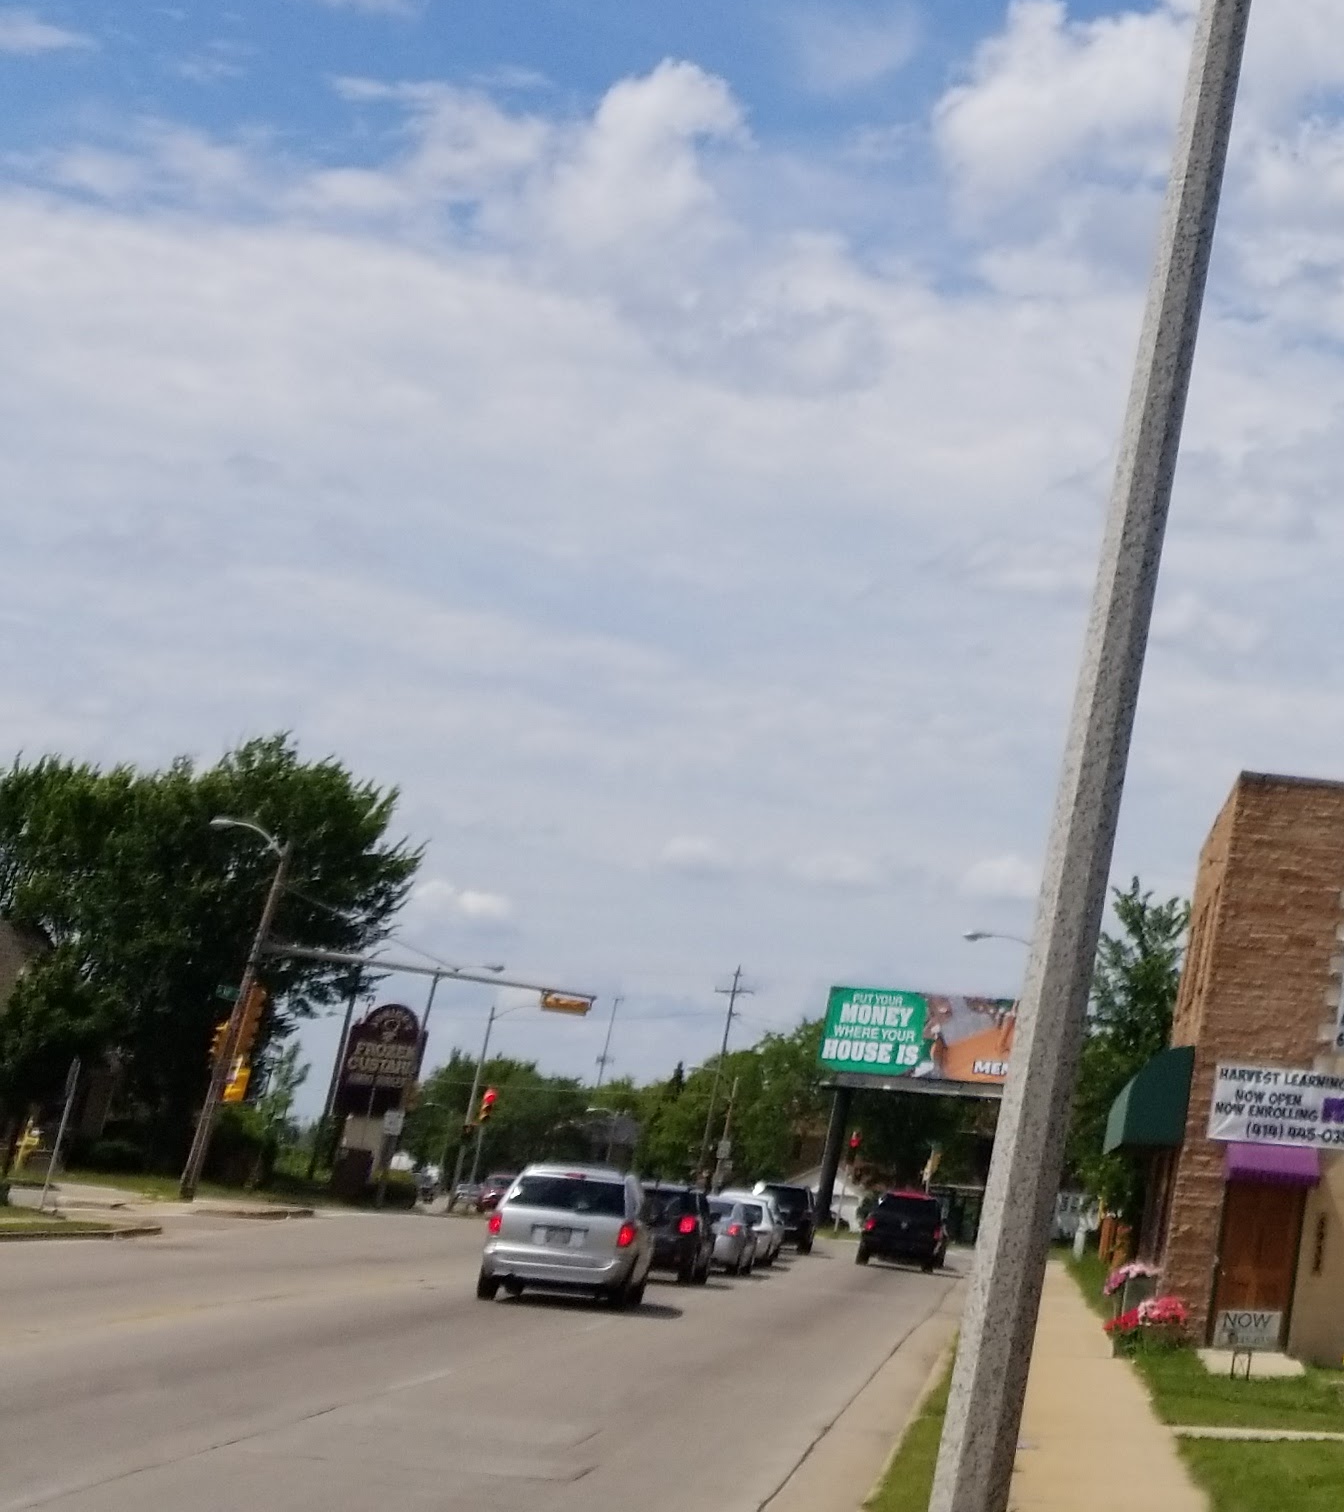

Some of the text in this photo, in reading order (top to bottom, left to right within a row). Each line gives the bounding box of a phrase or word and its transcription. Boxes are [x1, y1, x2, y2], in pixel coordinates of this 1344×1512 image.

[853, 993, 903, 1006] PUT YOUR
[840, 1002, 914, 1027] MONEY
[834, 1024, 915, 1042] WHERE YOUR
[822, 1038, 919, 1065] HOUSE IS
[1219, 1068, 1280, 1086] HARVEST
[1235, 1089, 1302, 1106] NOW OPEN
[1215, 1102, 1319, 1121] NOW ENROLLING
[1246, 1122, 1284, 1139] (414)
[1223, 1312, 1272, 1329] NOW
